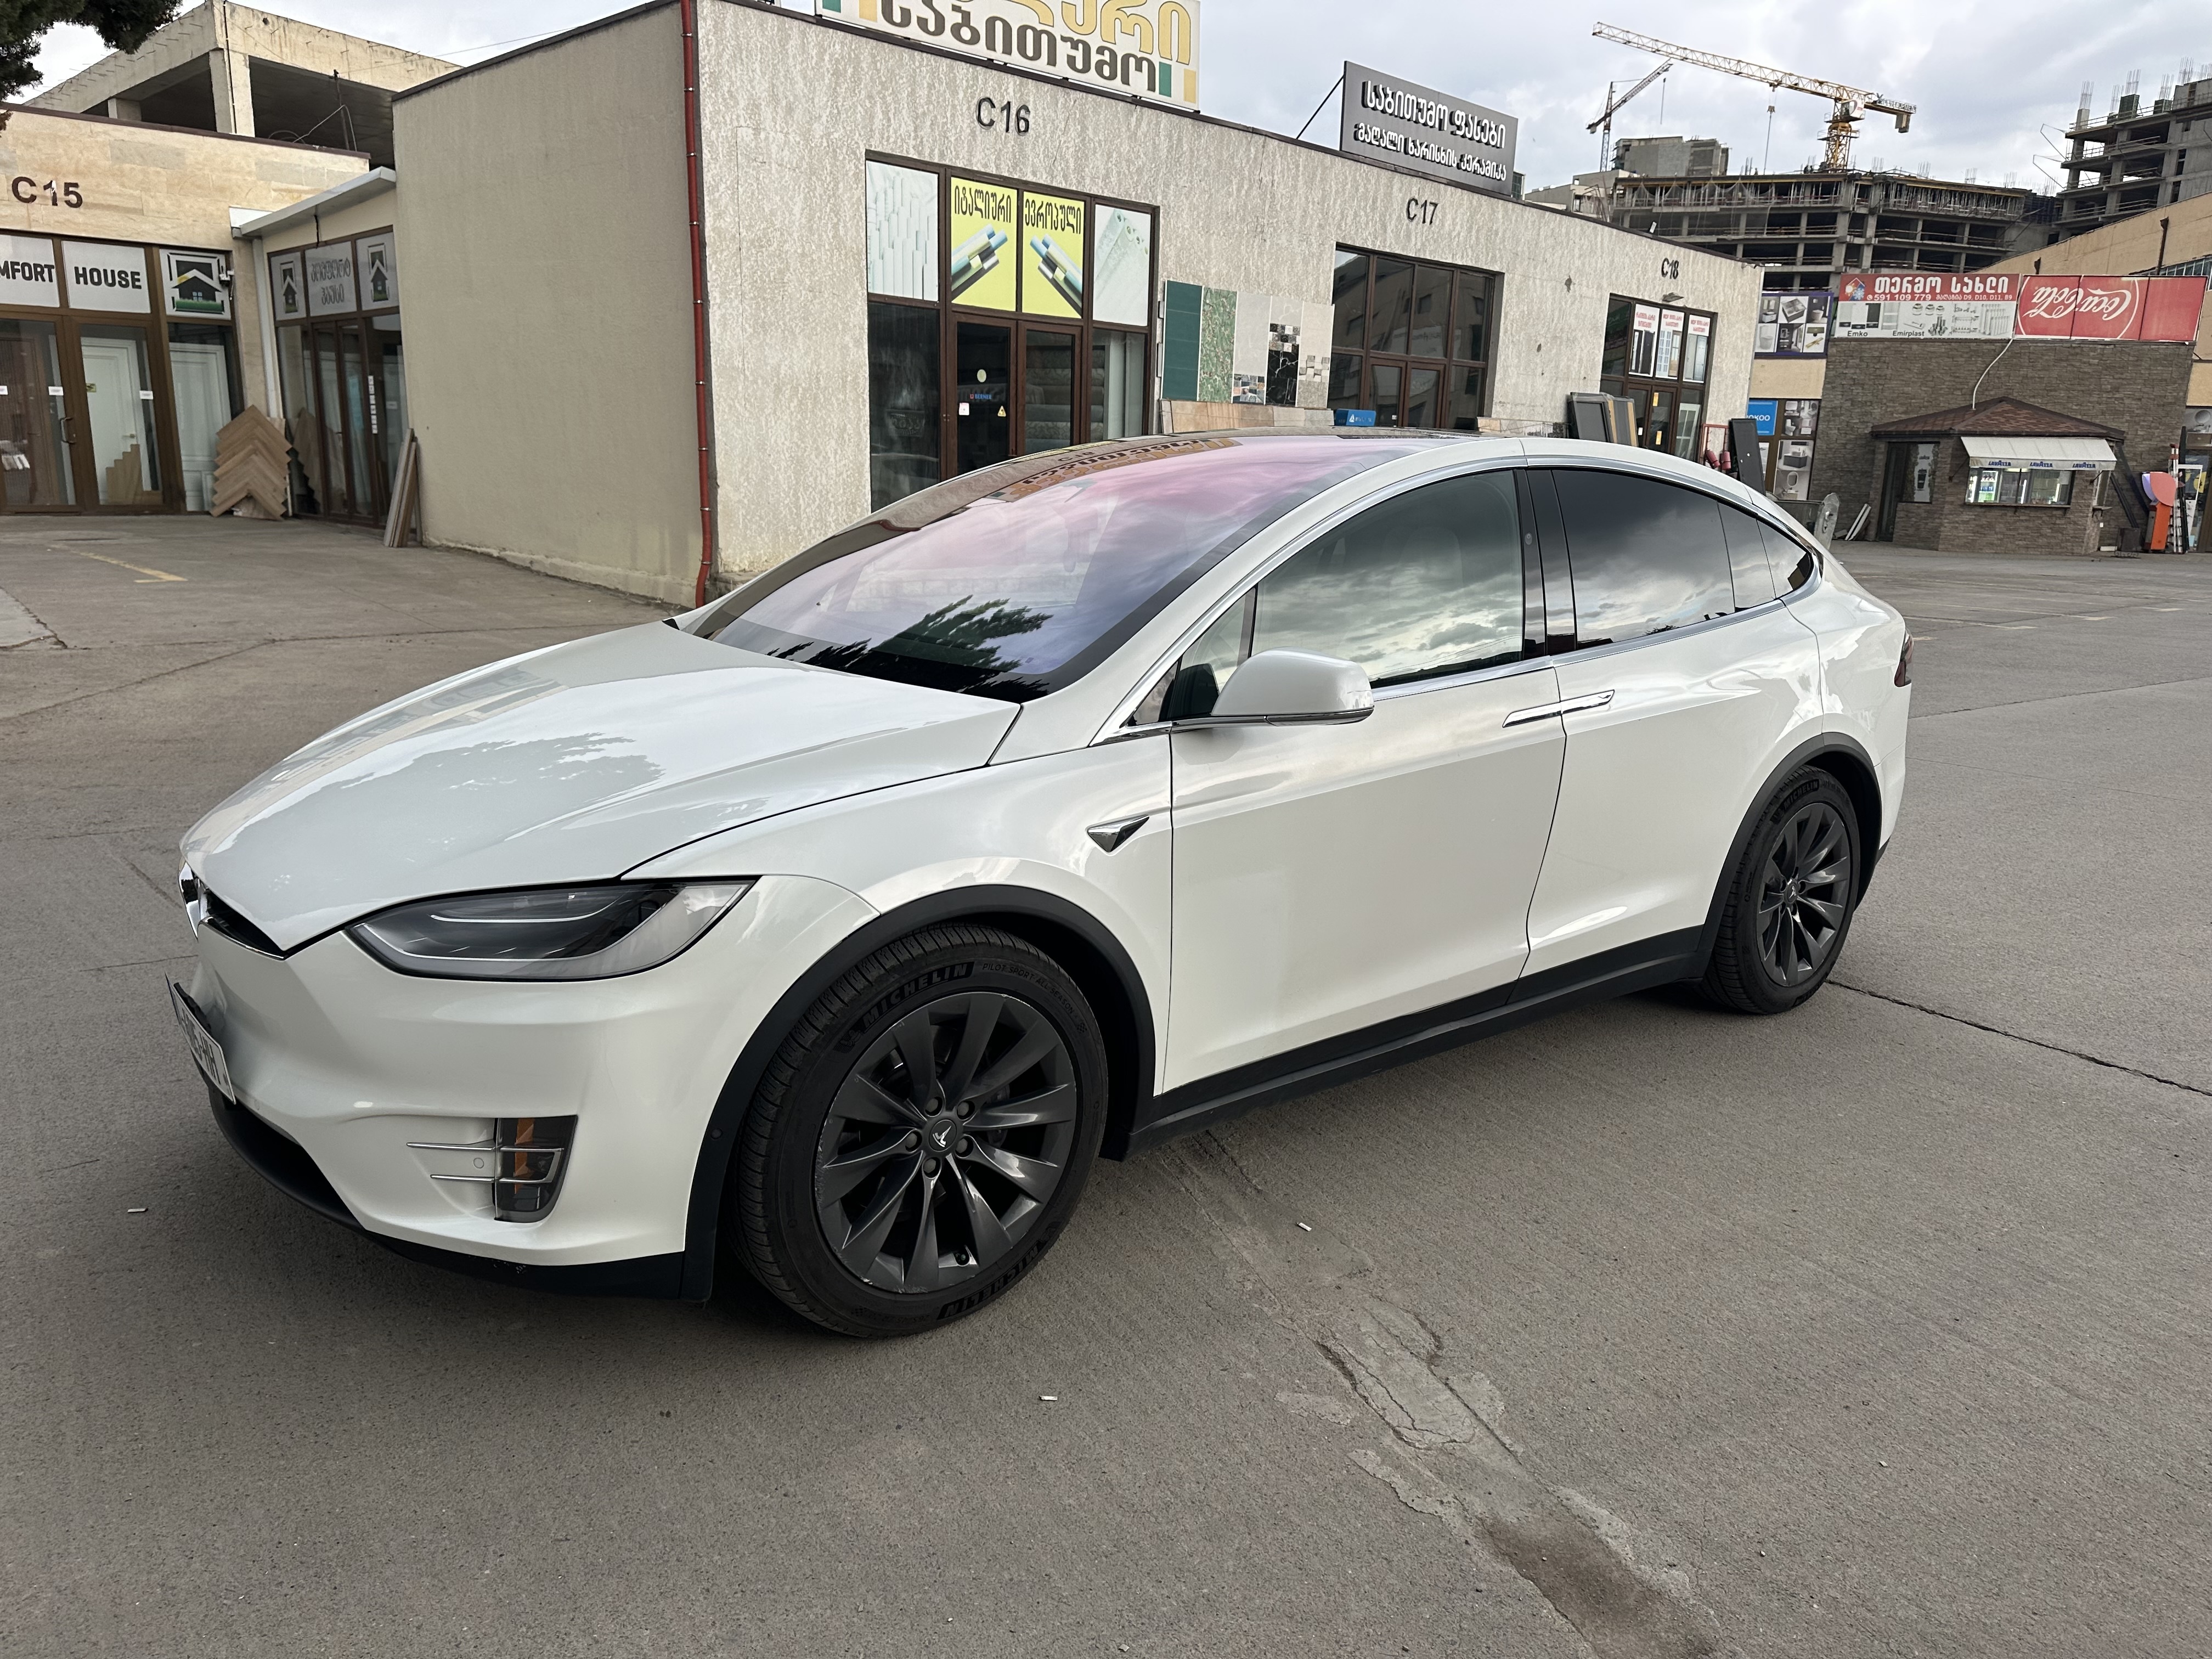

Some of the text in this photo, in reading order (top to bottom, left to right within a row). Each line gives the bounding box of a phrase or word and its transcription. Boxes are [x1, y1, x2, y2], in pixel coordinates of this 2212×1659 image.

[976, 97, 1030, 135] C16
[1364, 81, 1506, 149] საბითუმო ფასები
[1357, 122, 1506, 181] მაღალი ხარისხის კერამიკა
[12, 177, 83, 208] C15
[954, 185, 1012, 223] იტალიური
[1025, 199, 1082, 235] ევროპული
[1406, 198, 1438, 225] C17
[74, 266, 142, 289] HOUSE
[1661, 258, 1679, 280] C18
[1875, 276, 2009, 294] თერმო სახლი
[2022, 286, 2132, 321] Coca-Cola
[1784, 780, 1819, 810] MICHELIN
[863, 963, 967, 1027] MICHELIN
[982, 963, 1007, 971] PILOT
[1008, 966, 1036, 980] SPORT
[1035, 978, 1049, 990] ALL
[1049, 988, 1075, 1014] SEASON
[944, 1246, 1040, 1319] MICHELIN
